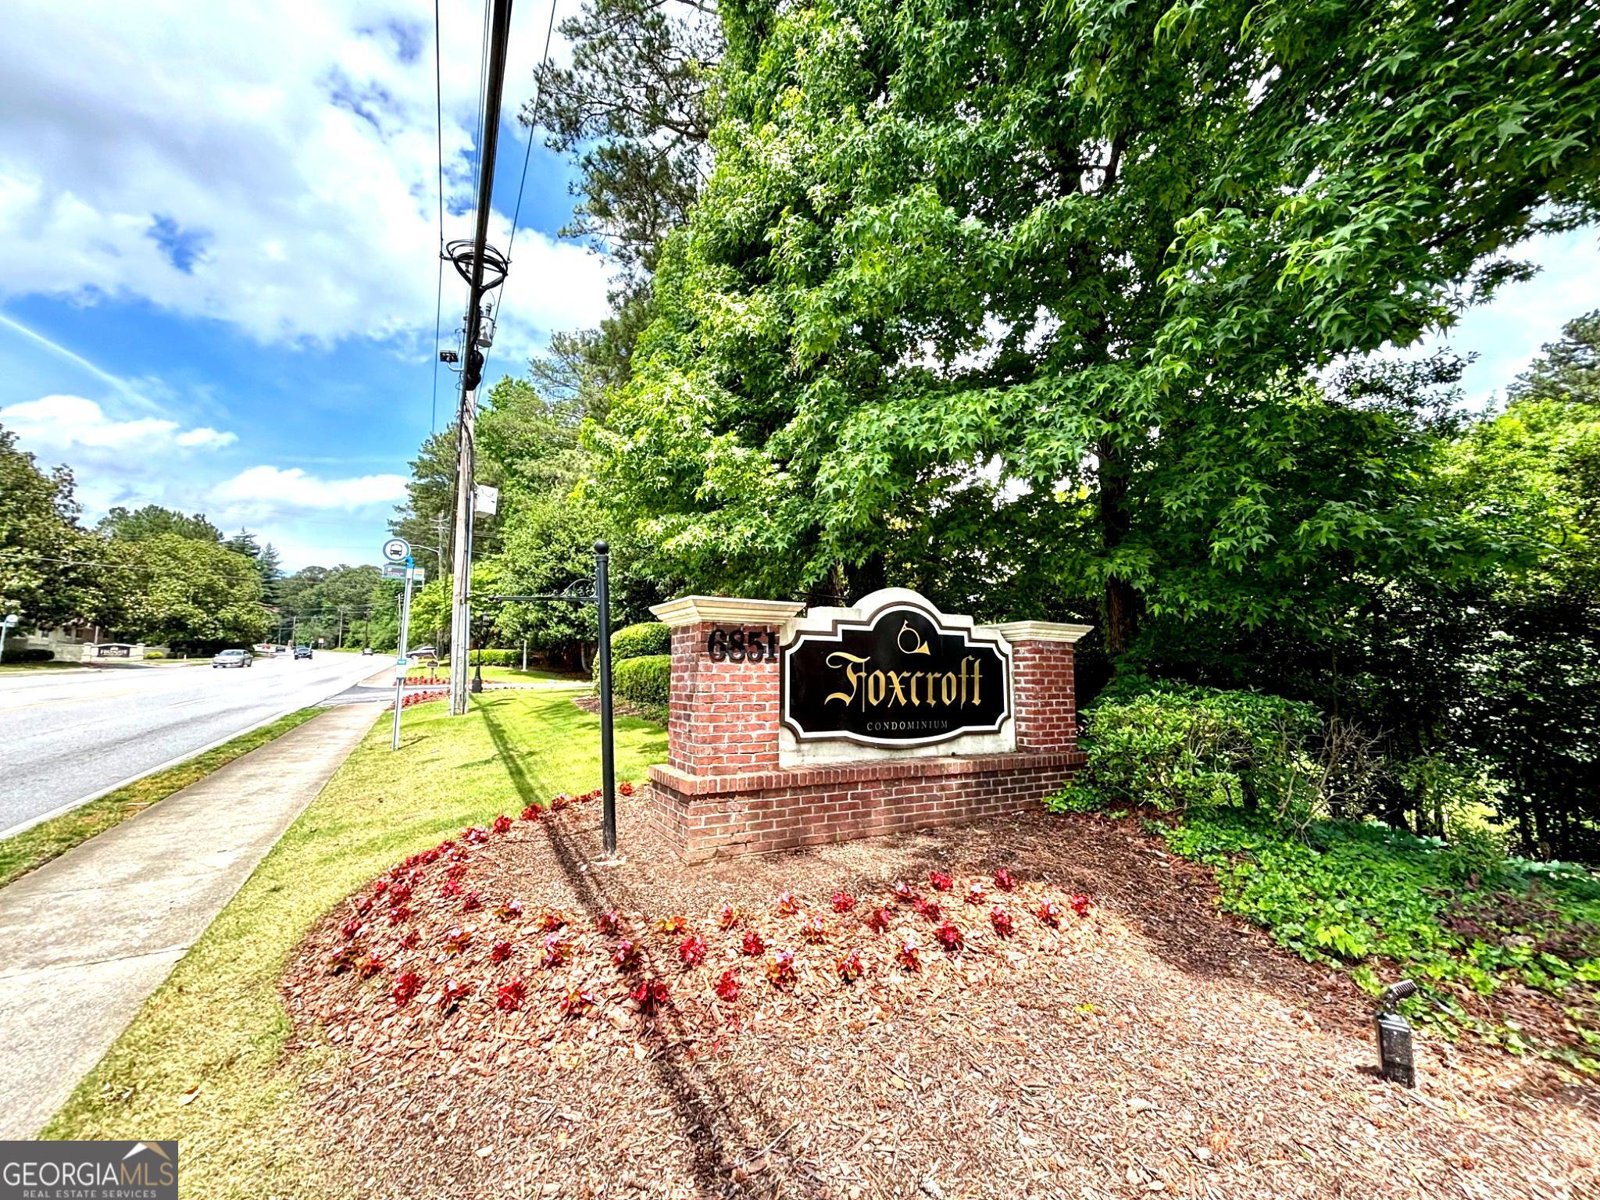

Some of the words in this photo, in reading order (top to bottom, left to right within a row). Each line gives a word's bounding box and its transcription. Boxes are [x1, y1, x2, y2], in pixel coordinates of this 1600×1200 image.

[708, 628, 778, 663] 6851
[824, 651, 984, 713] Foxcroft
[866, 720, 949, 731] CONDOMINIUM
